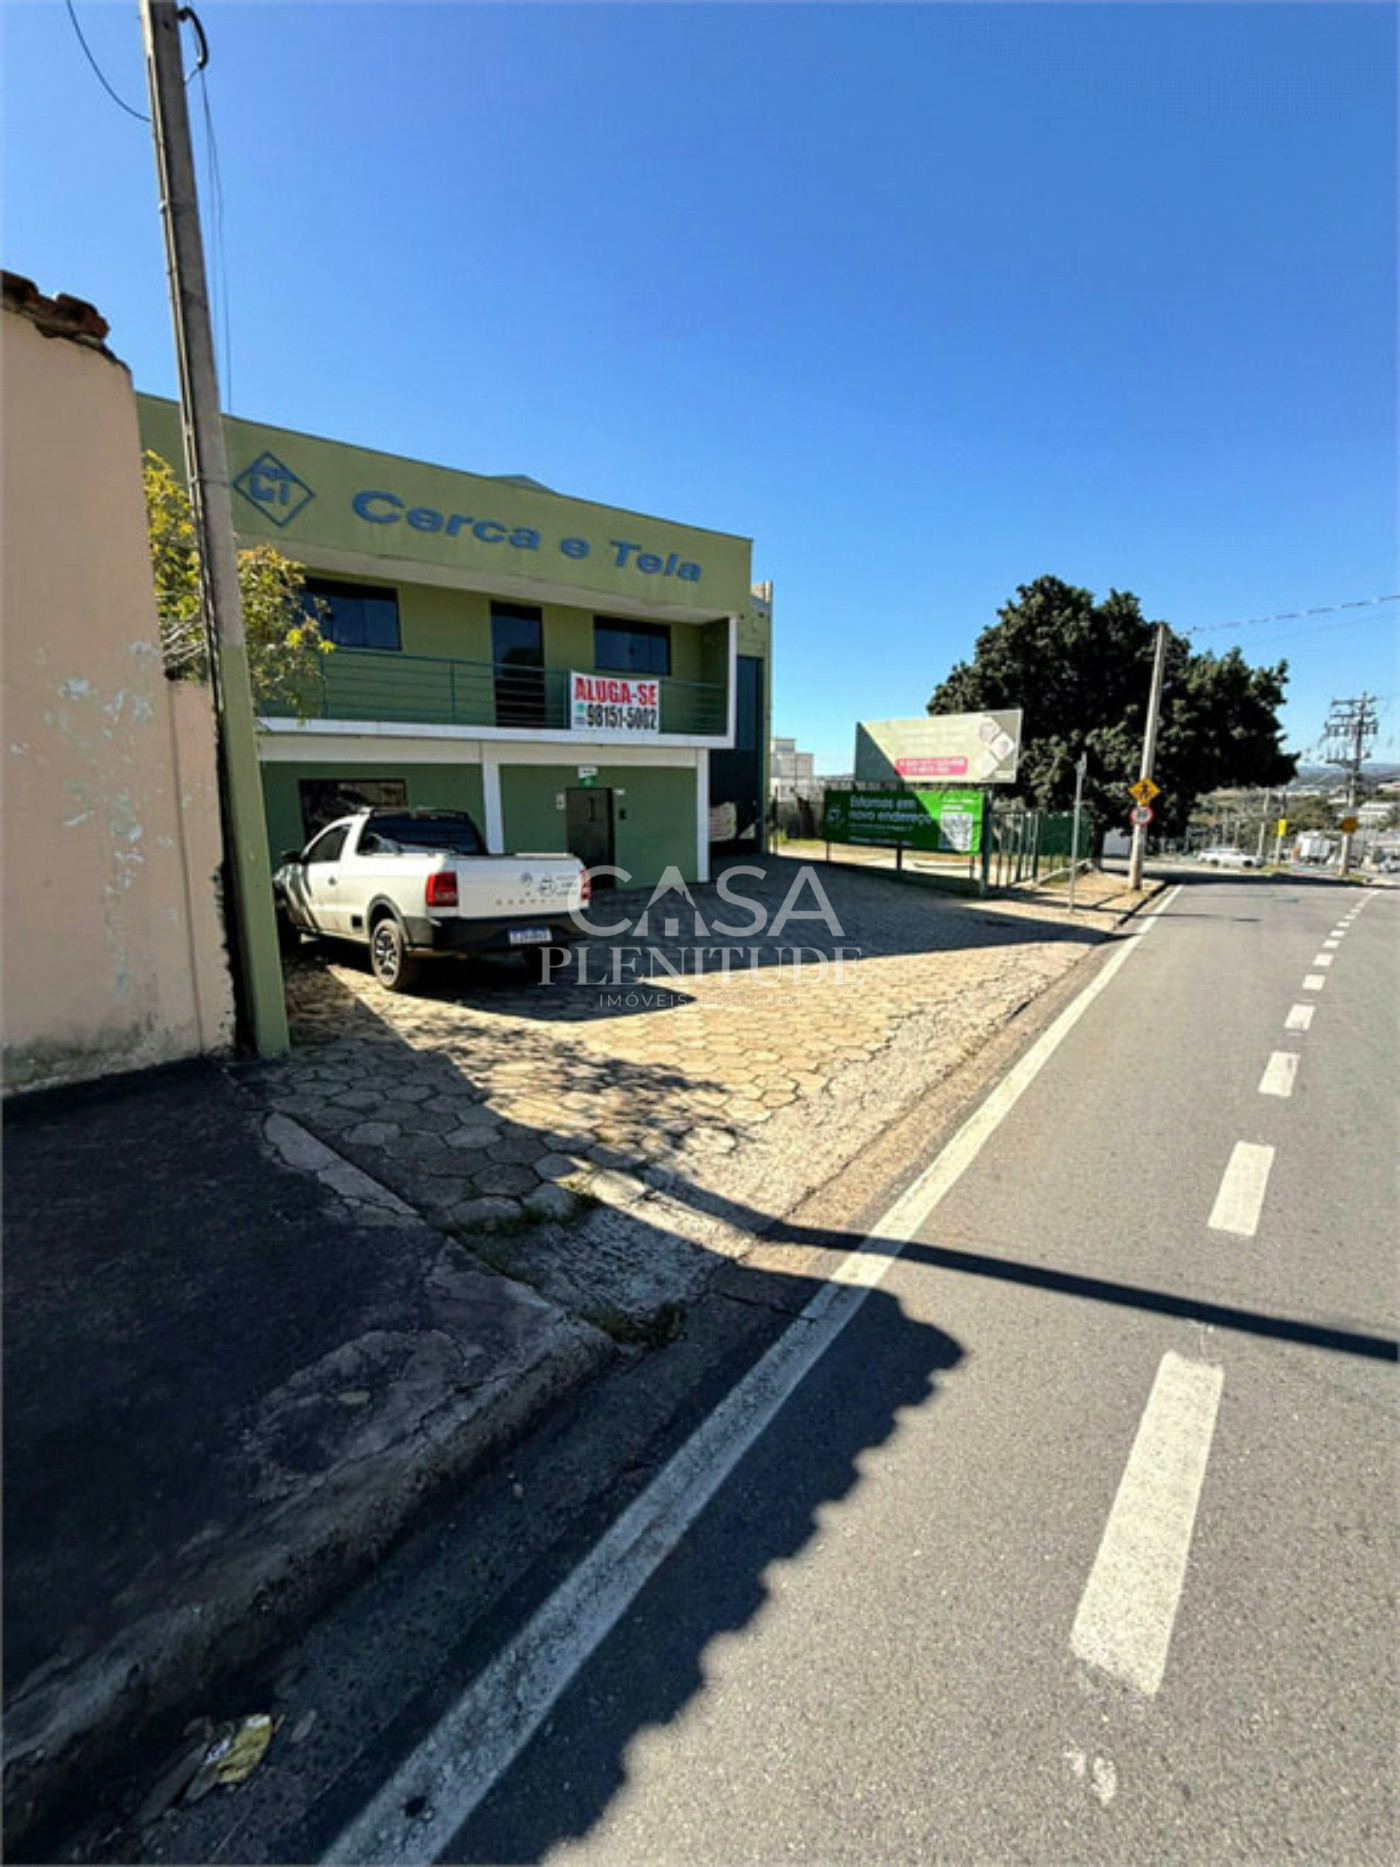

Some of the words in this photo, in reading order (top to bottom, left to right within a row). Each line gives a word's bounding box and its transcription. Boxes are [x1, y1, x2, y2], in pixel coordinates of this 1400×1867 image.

[352, 490, 541, 551] Cerca
[559, 537, 591, 560] e
[609, 539, 703, 583] Tela
[574, 677, 657, 706] ALUGA-SE
